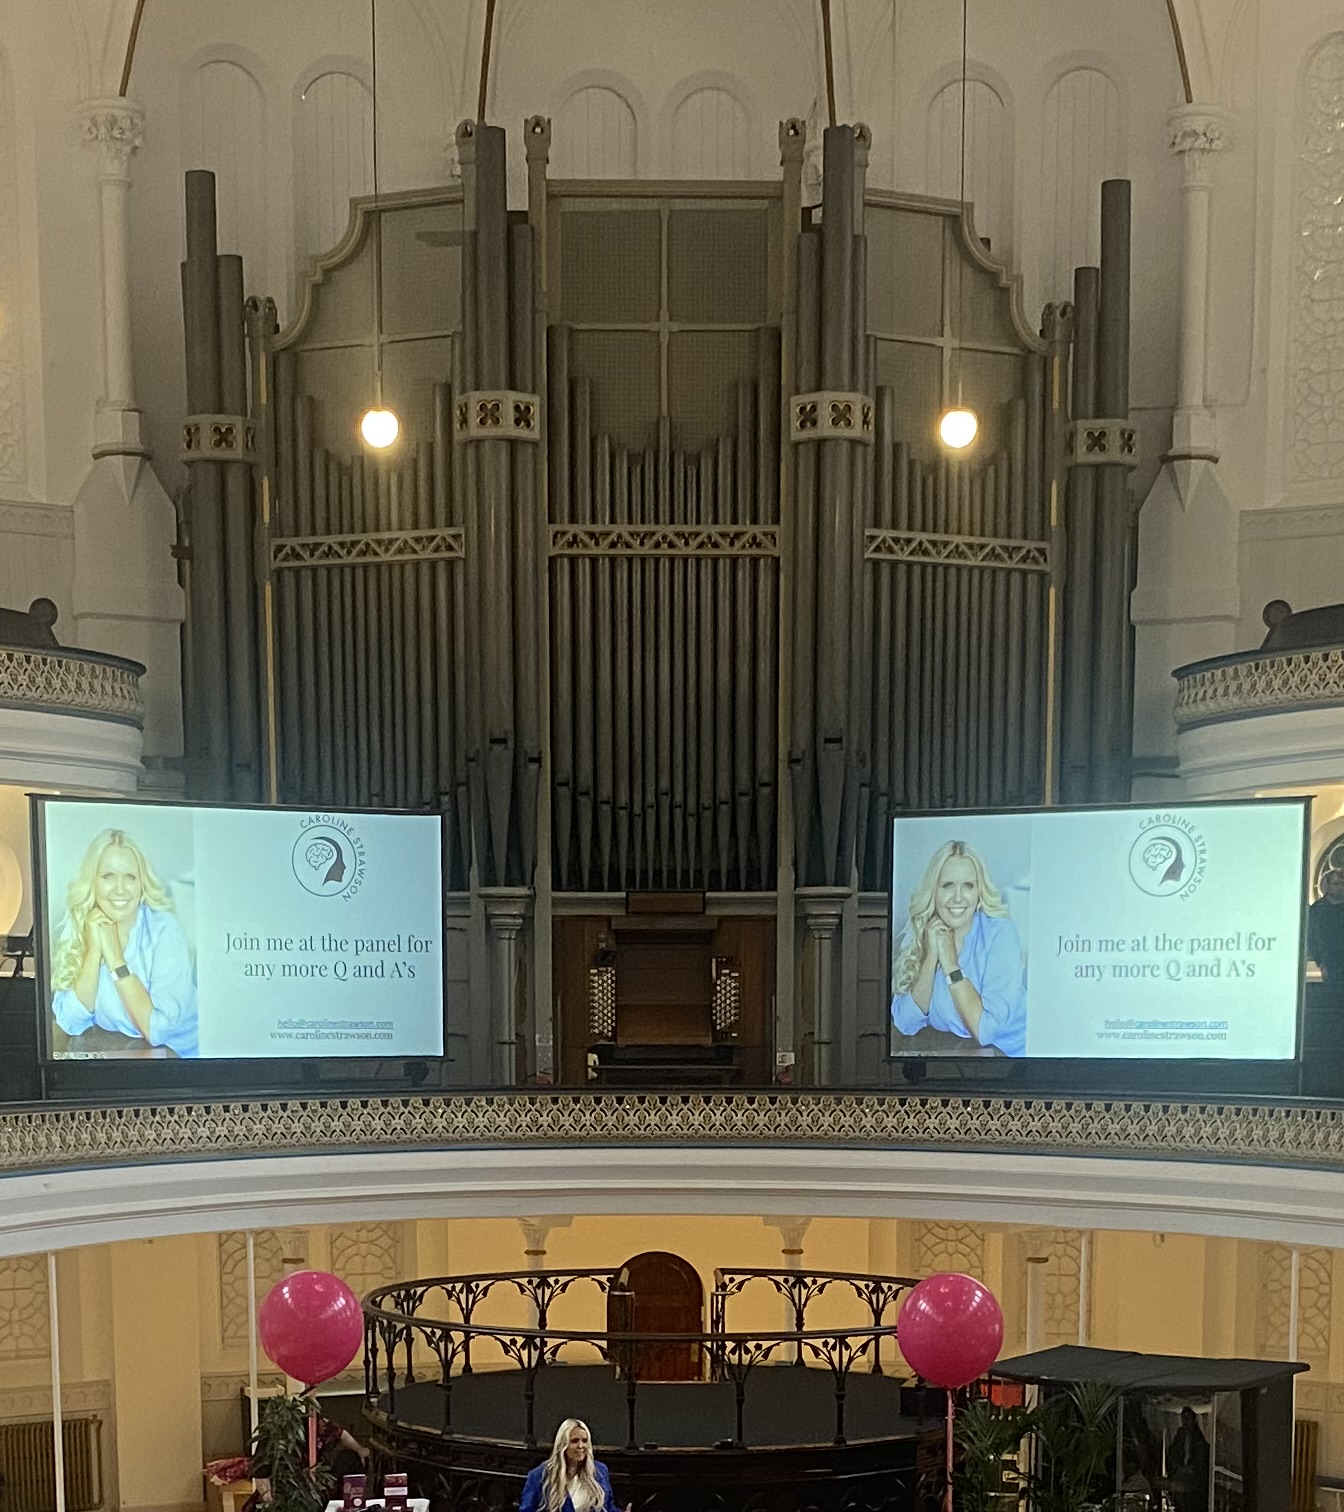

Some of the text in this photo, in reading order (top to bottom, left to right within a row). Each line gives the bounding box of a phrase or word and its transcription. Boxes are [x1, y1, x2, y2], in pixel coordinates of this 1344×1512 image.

[300, 814, 366, 902] CAROLINE STRAWSON
[1139, 813, 1207, 902] CAROLINE STRAWSON
[225, 932, 433, 956] Join me at the panel for
[1056, 932, 1277, 956] Join me at the panel for
[244, 963, 275, 980] any
[281, 964, 328, 977] more
[333, 961, 348, 981] Q
[353, 960, 385, 978] and
[1074, 964, 1105, 981] any
[1112, 965, 1160, 978] more
[1166, 960, 1182, 981] Q
[1186, 959, 1221, 978] and
[269, 1029, 393, 1040] www.carolinestrawson.com
[1096, 1030, 1227, 1040] www.carolinestrawson.com
